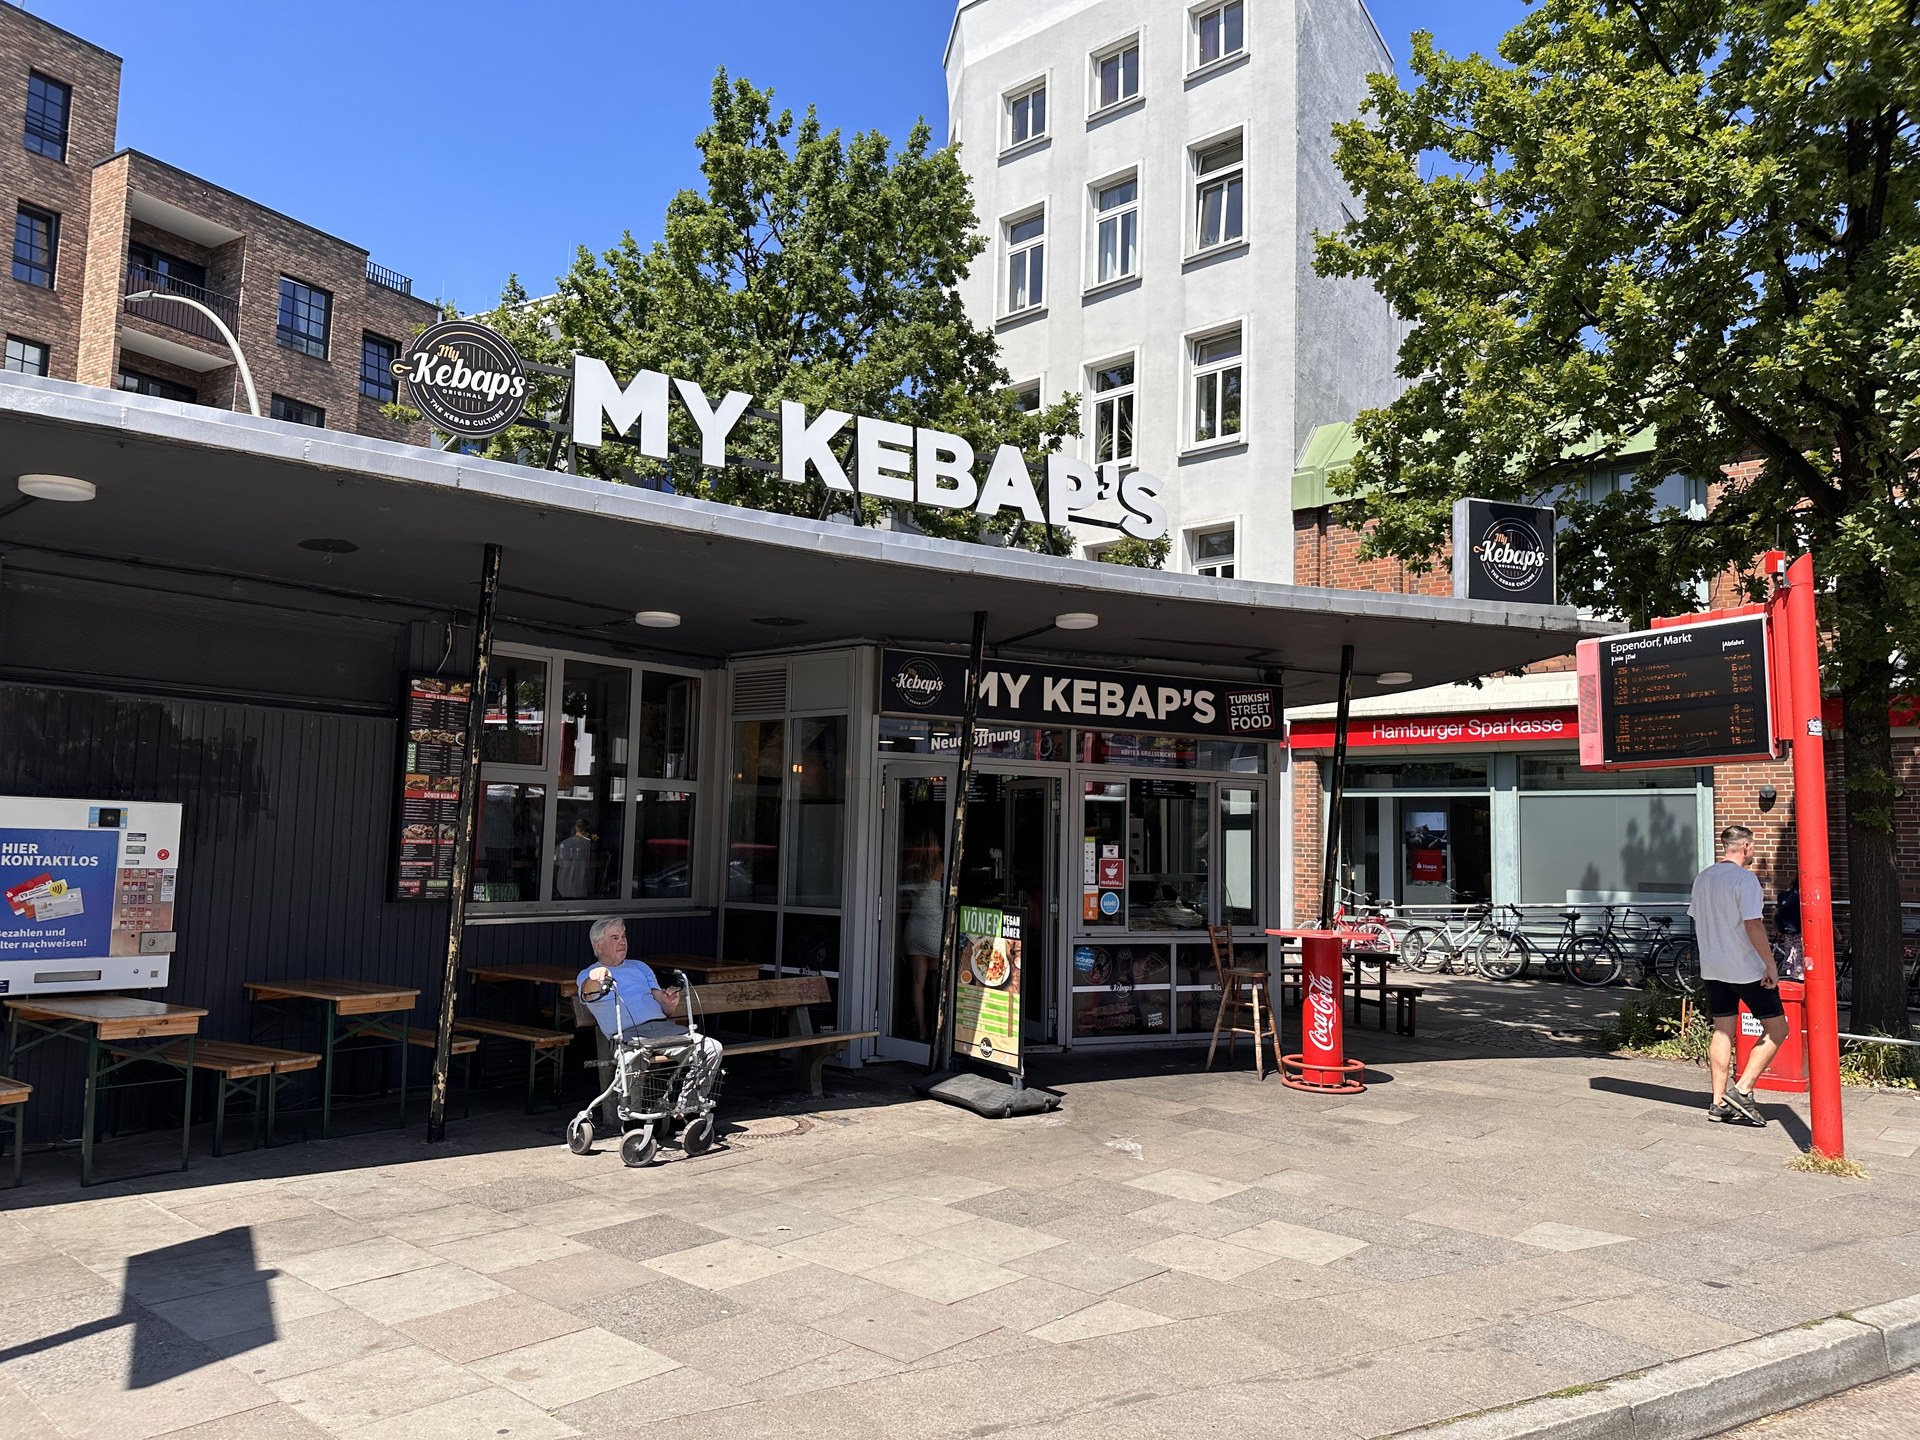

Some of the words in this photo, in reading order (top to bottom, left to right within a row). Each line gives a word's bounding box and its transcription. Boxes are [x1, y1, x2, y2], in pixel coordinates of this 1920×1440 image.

[437, 344, 460, 362] My
[409, 352, 526, 402] Kebap's
[442, 388, 482, 400] ORIGINAL
[430, 398, 443, 413] THE
[443, 411, 471, 426] KEBAB
[472, 410, 505, 427] CULTURE
[572, 353, 754, 469] MY
[780, 400, 1167, 541] KEBAP'S
[1494, 532, 1508, 546] My
[1480, 540, 1545, 571] Kebap's
[1490, 569, 1499, 580] THE
[1498, 576, 1515, 587] KEBAB
[1516, 573, 1536, 587] CULTURE
[1611, 636, 1662, 654] Eppendorf,
[1664, 633, 1693, 646] Markt
[895, 673, 944, 694] Kebap's
[964, 668, 1031, 708] MY
[1042, 676, 1217, 724] KEBAP'S
[1228, 693, 1270, 704] TURKISH
[1230, 703, 1270, 716] STREET
[1231, 715, 1272, 730] FOOD
[1372, 721, 1464, 741] Hamburger
[1468, 718, 1564, 738] Sparkasse
[407, 743, 416, 772] VEGGIES
[1, 842, 39, 854] HIER
[1, 855, 99, 867] KONTAKTLOS
[963, 907, 999, 935] VÖNER
[1002, 914, 1020, 927] VEGAN
[45, 928, 66, 937] und
[1002, 925, 1020, 939] DÖNER
[0, 941, 20, 949] lter
[21, 938, 87, 949] nachweisen!
[1308, 969, 1334, 1051] Coca-Cola
